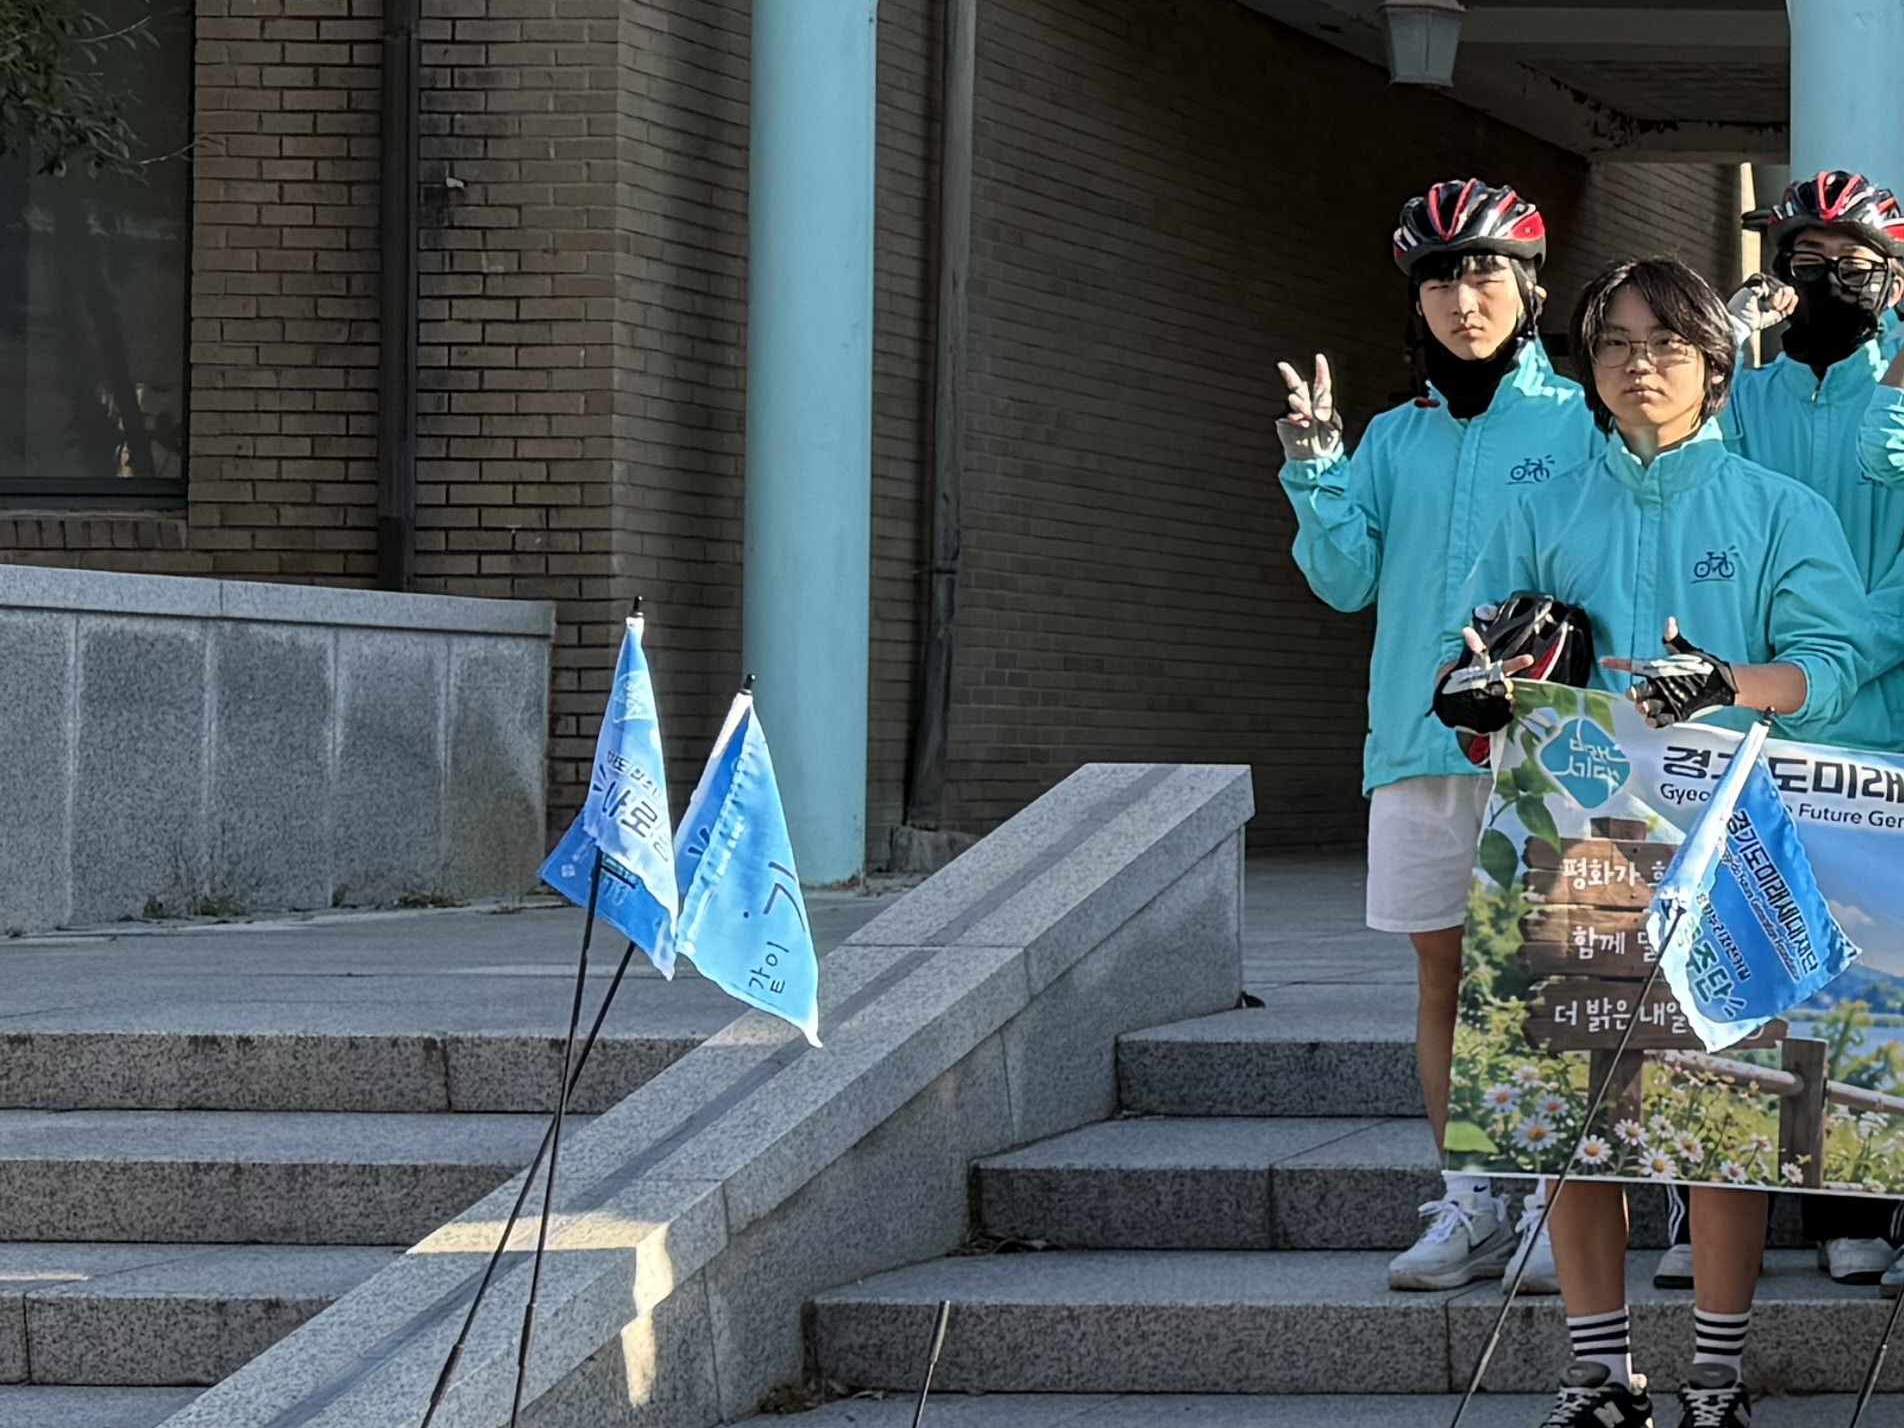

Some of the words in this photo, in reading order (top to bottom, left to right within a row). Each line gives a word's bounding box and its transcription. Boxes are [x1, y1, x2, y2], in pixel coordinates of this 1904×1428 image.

[602, 781, 658, 839] 나로
[1798, 803, 1863, 826] Future
[1562, 856, 1638, 891] 평화가
[1572, 926, 1626, 961] 함께
[1555, 1004, 1578, 1026] 더
[1586, 999, 1632, 1034] 밝은
